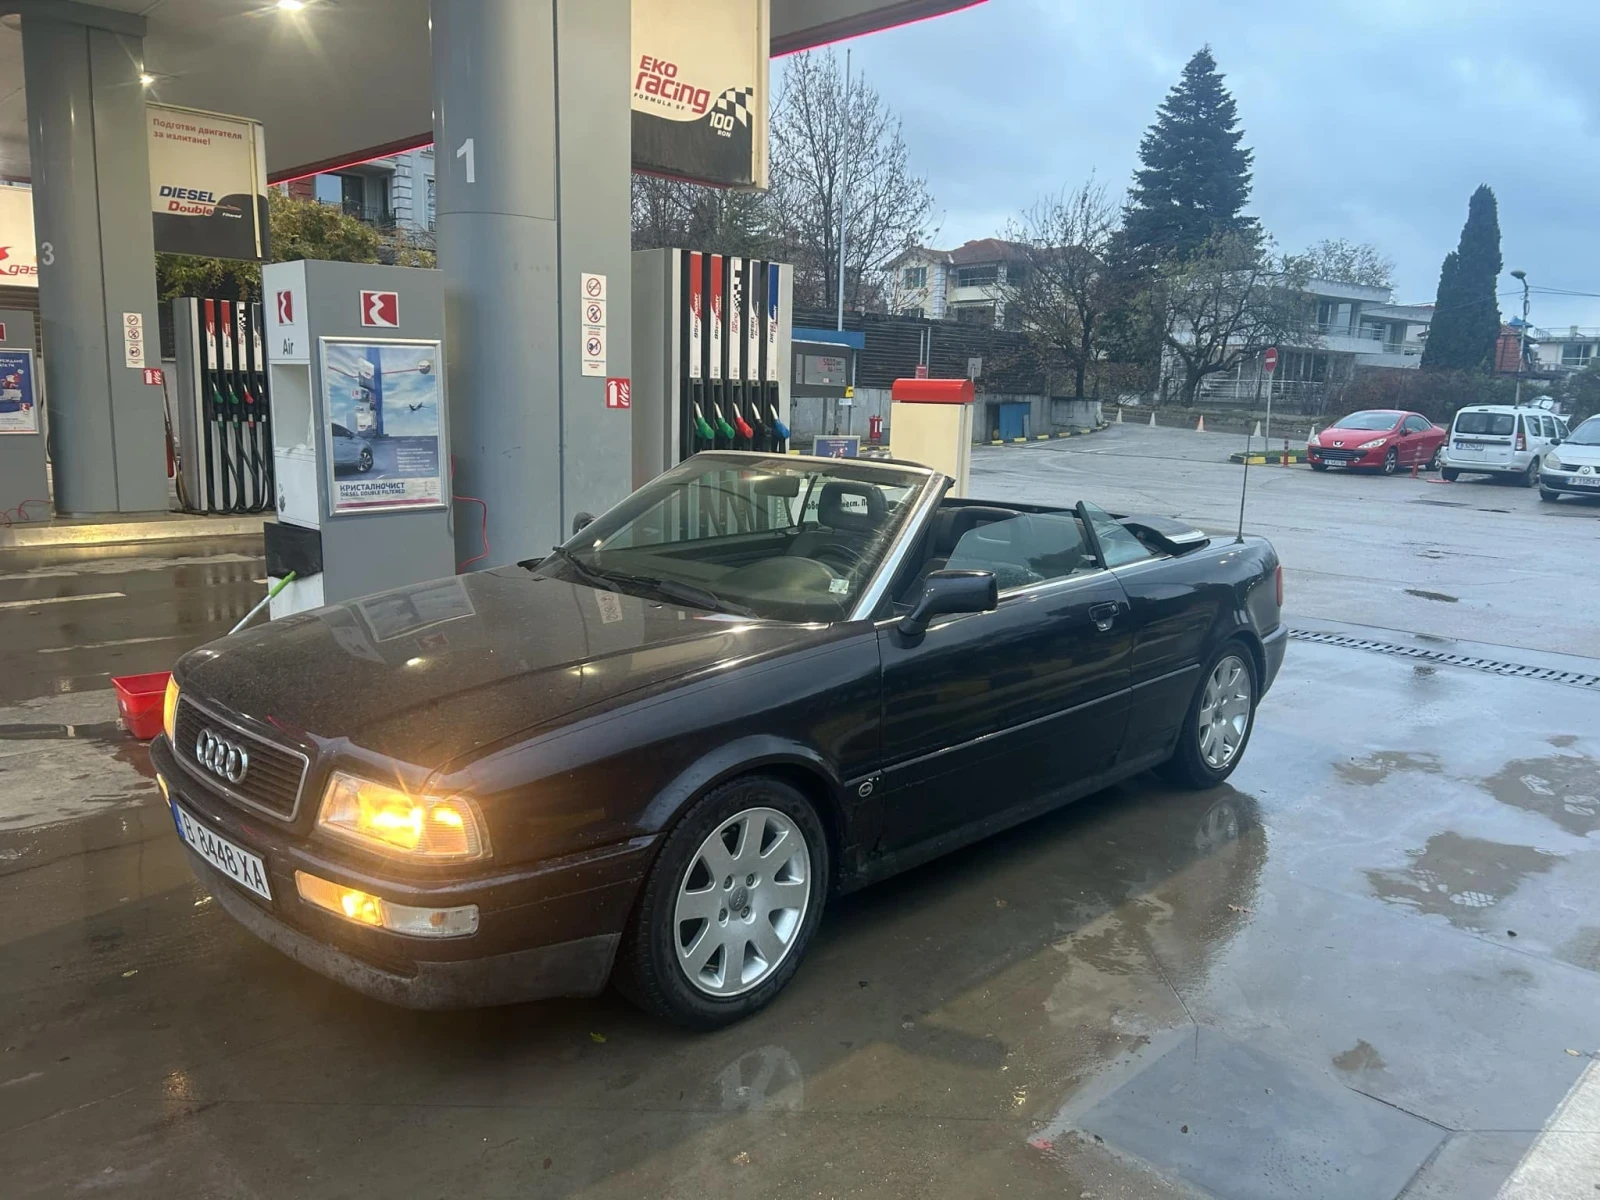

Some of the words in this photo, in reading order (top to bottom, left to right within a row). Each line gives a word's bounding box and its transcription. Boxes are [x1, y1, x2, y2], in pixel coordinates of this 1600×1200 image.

[639, 54, 678, 78] EKO
[633, 92, 672, 107] FORMULA
[635, 71, 711, 115] racing
[153, 118, 197, 132] Подготви
[198, 126, 242, 140] двигателя
[709, 111, 735, 132] 100
[166, 133, 211, 146] излитане!
[717, 129, 731, 138] RON
[456, 138, 476, 183] 1
[159, 185, 216, 203] DIESEL
[168, 200, 213, 216] Double
[41, 241, 55, 266] 3
[8, 264, 38, 276] gas
[282, 337, 294, 355] Air
[340, 482, 405, 491] КРИСТАЛНОЧИСТ
[182, 813, 195, 844] B
[197, 826, 239, 876] 8448
[237, 851, 267, 892] XA
